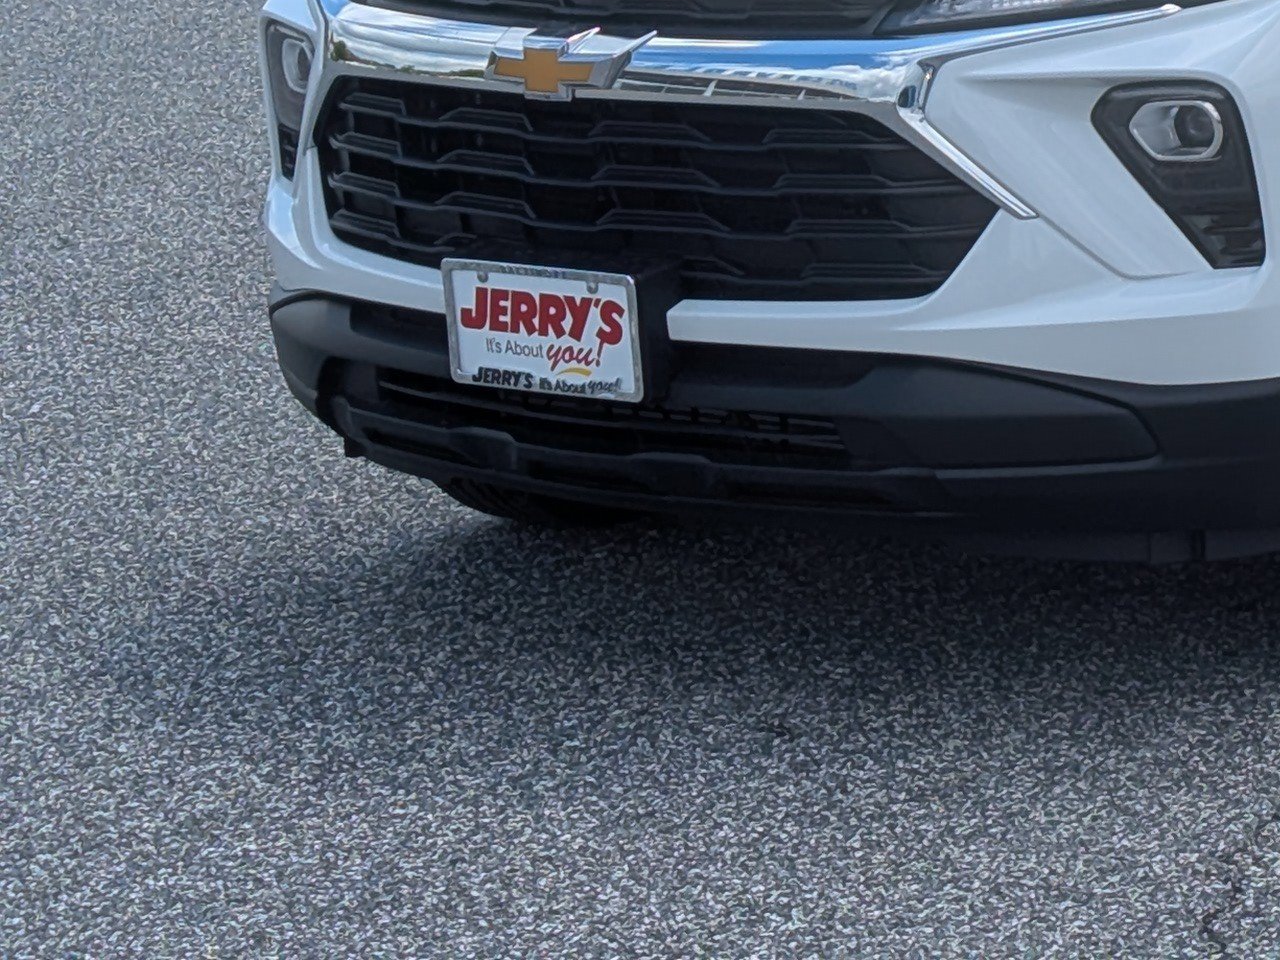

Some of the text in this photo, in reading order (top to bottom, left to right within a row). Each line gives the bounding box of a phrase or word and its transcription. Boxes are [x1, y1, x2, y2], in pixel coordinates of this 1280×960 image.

[460, 286, 626, 346] JERRY'S
[486, 338, 601, 372] It's About you!
[471, 366, 534, 389] JERRY'S
[554, 380, 587, 395] About
